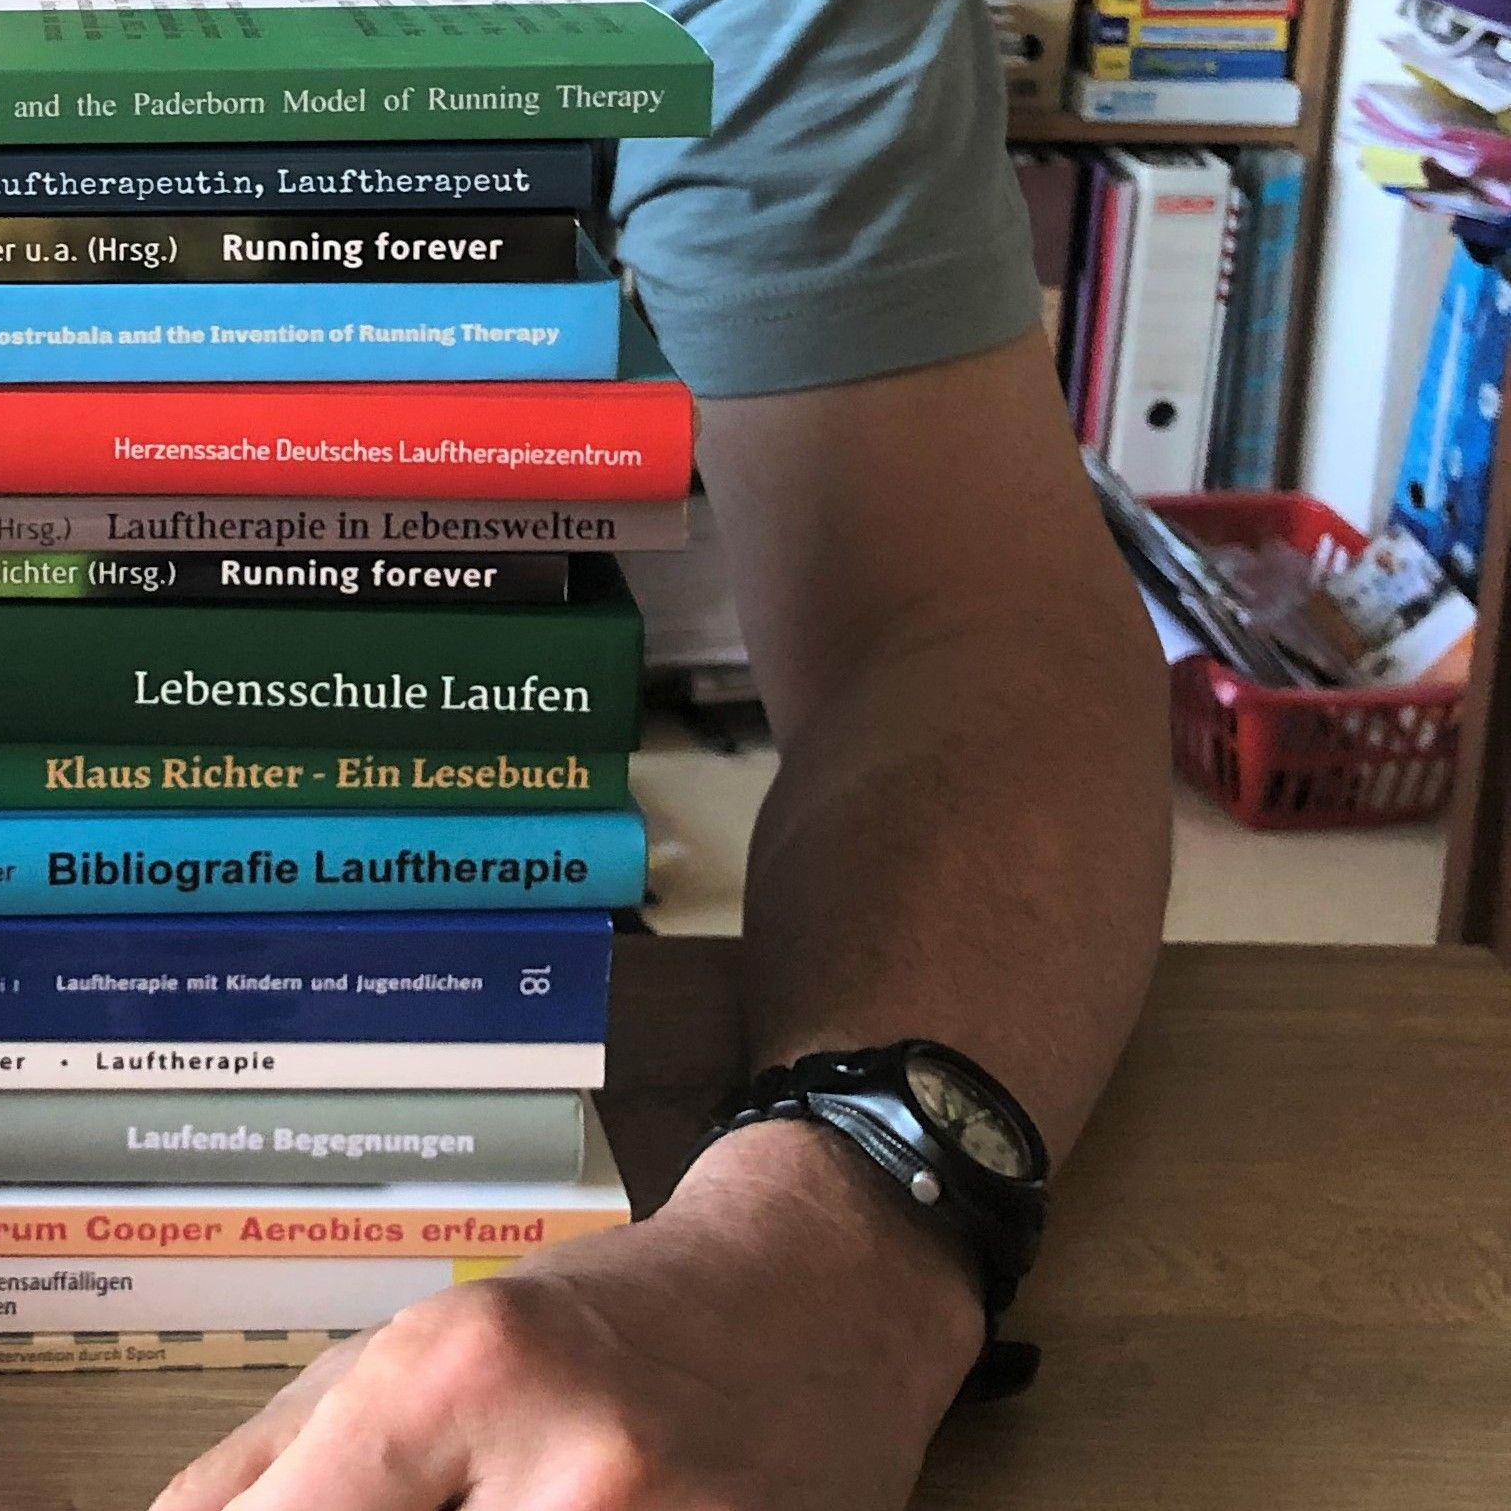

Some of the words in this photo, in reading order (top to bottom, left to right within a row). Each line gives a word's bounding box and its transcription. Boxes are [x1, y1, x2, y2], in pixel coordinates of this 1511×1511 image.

[15, 94, 60, 117] and
[77, 93, 116, 116] the
[135, 91, 264, 115] Paderborn
[284, 89, 365, 113] Model
[384, 87, 415, 111] of
[429, 86, 539, 115] Running
[556, 85, 664, 113] Therapy
[278, 169, 529, 198] Lauftherapeut
[89, 237, 177, 268] (Hrsg.)
[224, 232, 363, 268] Running
[375, 232, 503, 260] forever
[119, 326, 161, 344] and
[167, 326, 205, 343] the
[210, 325, 324, 344] Invention
[328, 324, 354, 342] of
[359, 324, 456, 346] Running
[461, 324, 559, 345] Therapy
[115, 438, 270, 460] Herzenssache
[277, 439, 393, 462] Deutsches
[400, 440, 641, 469] Lauftherapiezentrum
[108, 512, 327, 544] Lauftherapie
[339, 512, 369, 539] in
[384, 509, 617, 541] Lebenswelten
[89, 561, 175, 591] (Hrsg.)
[222, 560, 359, 594] Running
[372, 560, 497, 587] forever
[135, 671, 427, 709] Lebensschule
[441, 675, 590, 712] Laufen
[46, 756, 150, 789] Klaus
[162, 755, 303, 788] Richter
[336, 755, 400, 788] Ein
[412, 756, 589, 789] Lesebuch
[49, 851, 298, 892] Bibliografie
[316, 850, 588, 889] Lauftherapie
[57, 975, 178, 994] Lauftherapie
[187, 975, 218, 991] mit
[227, 975, 302, 990] Kindern
[311, 974, 347, 991] und
[356, 974, 482, 994] Jugendlichen
[519, 965, 551, 996] 18
[97, 1052, 274, 1074] Lauftherapie
[127, 1124, 267, 1151] Laufende
[274, 1128, 476, 1157] Begegnungen
[86, 1216, 221, 1247] Cooper
[240, 1217, 403, 1241] Aerobics
[422, 1218, 543, 1242] erfand
[126, 1347, 166, 1364] Sport
